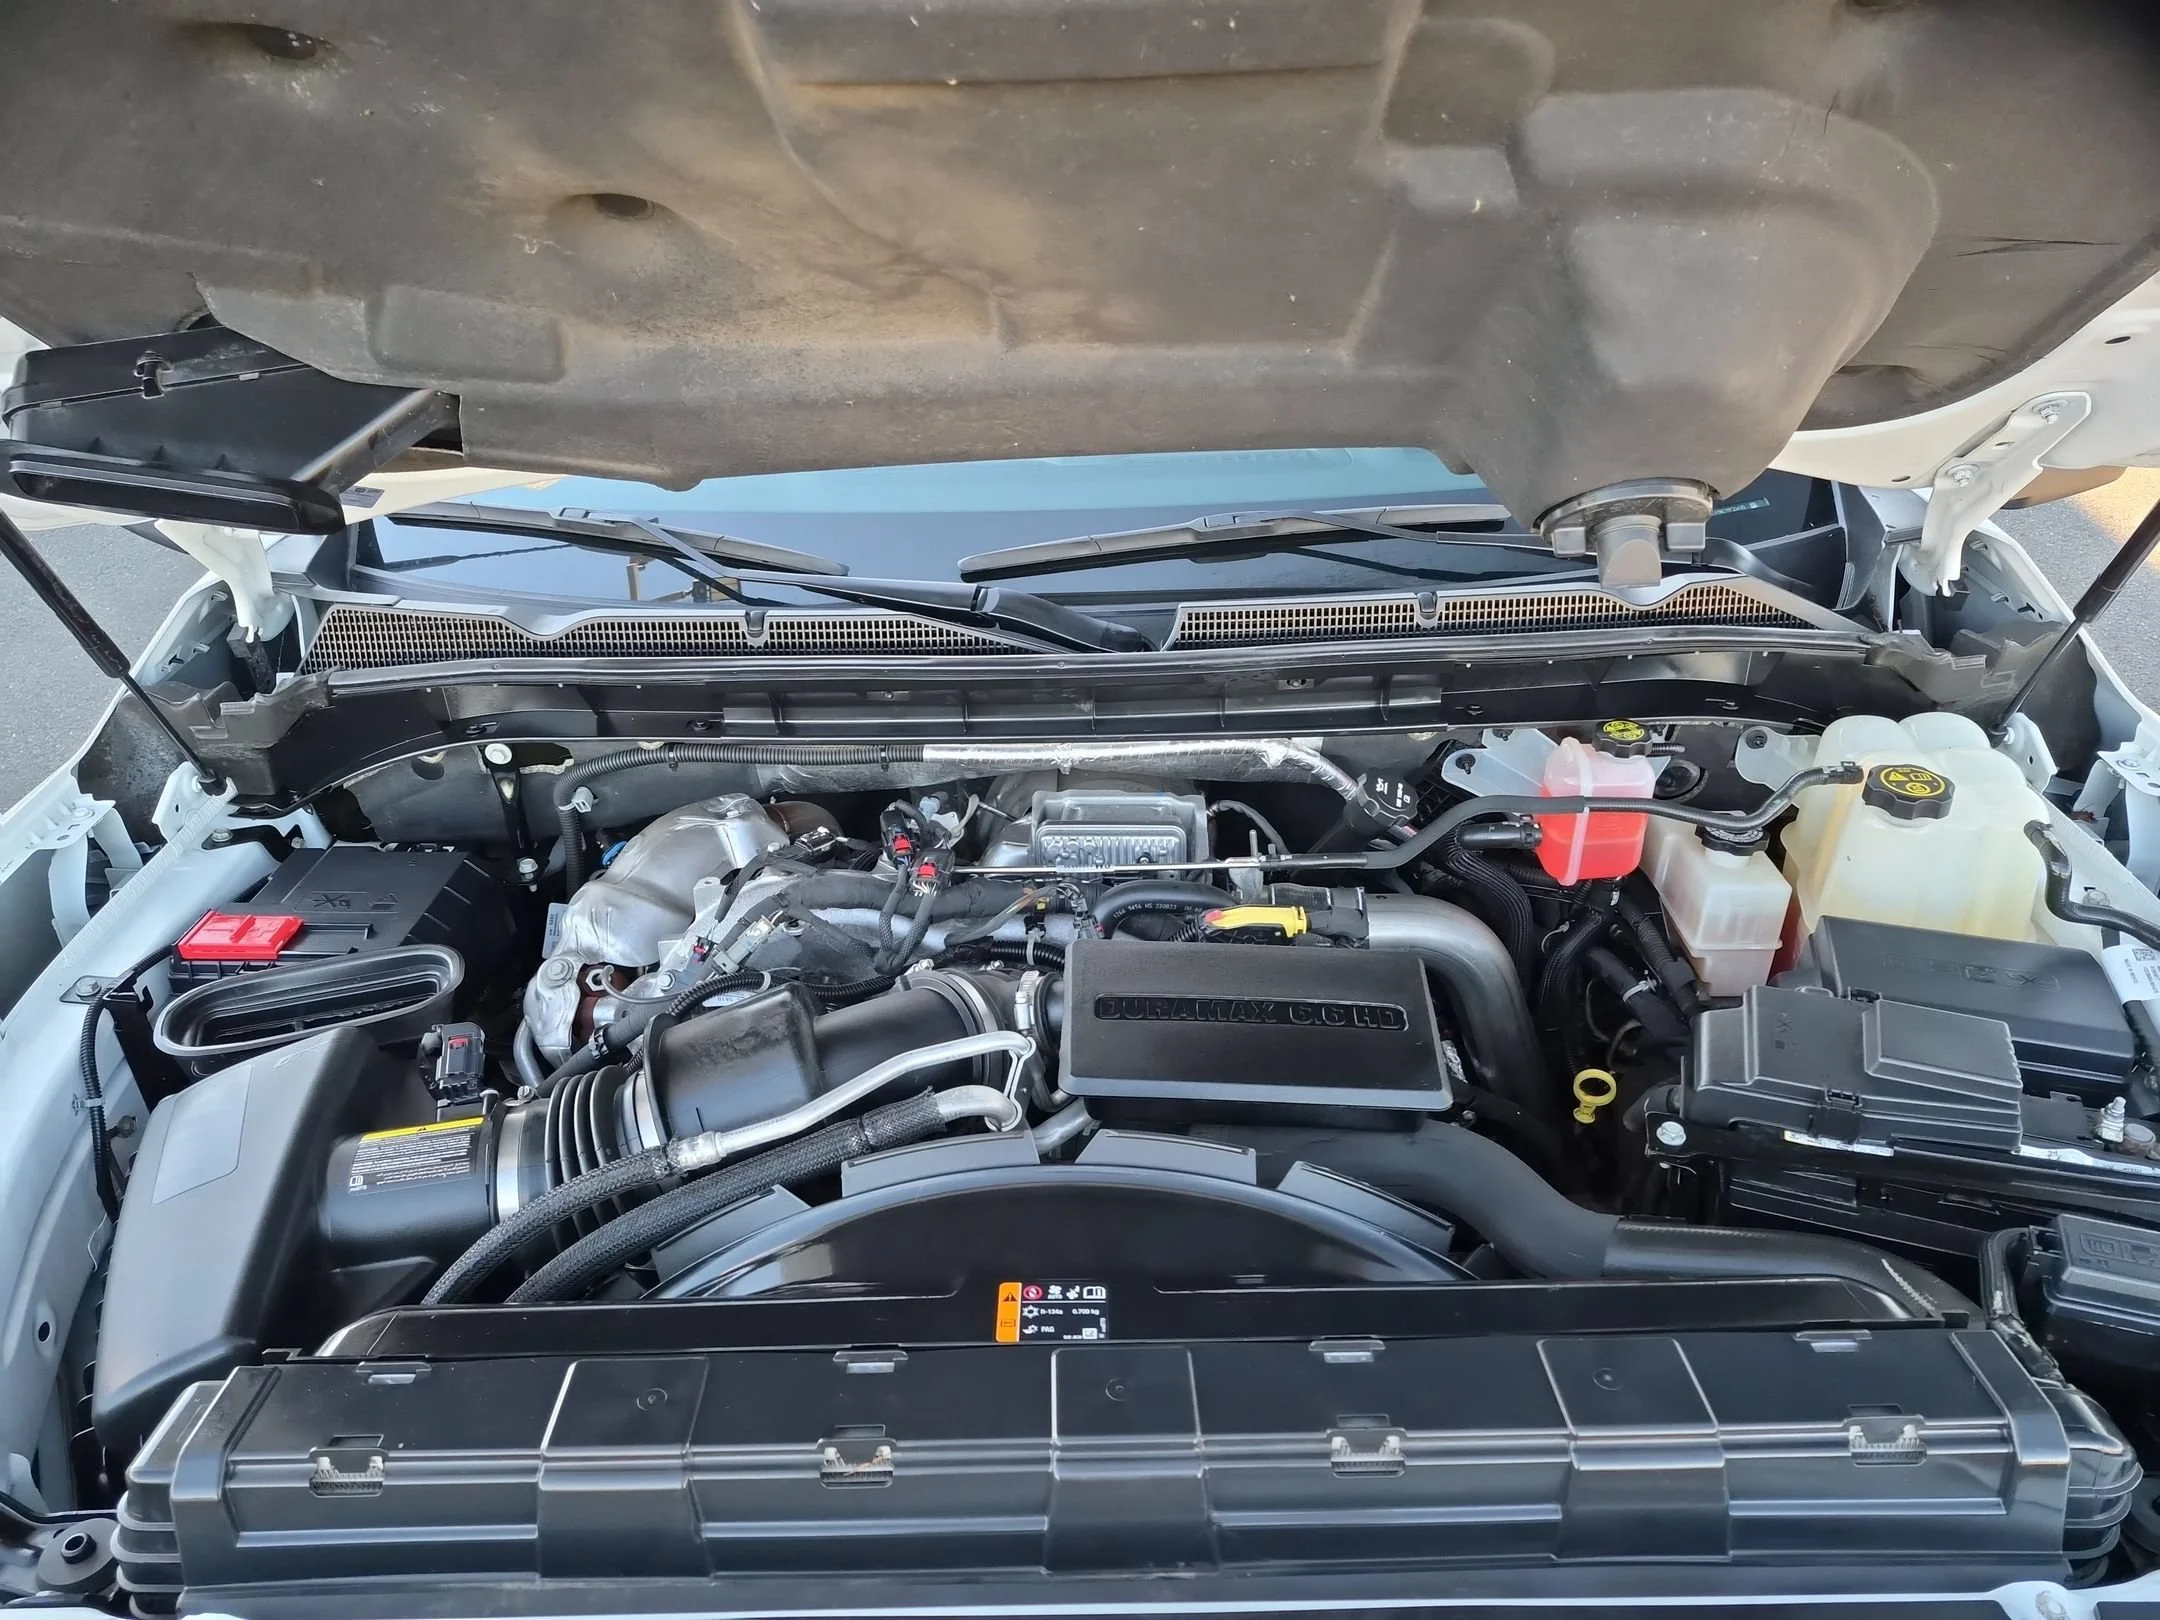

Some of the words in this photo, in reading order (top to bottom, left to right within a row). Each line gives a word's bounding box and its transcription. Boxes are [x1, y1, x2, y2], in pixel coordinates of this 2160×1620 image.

[1099, 996, 1277, 1023] DURAMAX
[1289, 1002, 1348, 1026] 6.6
[1353, 1006, 1404, 1030] HD
